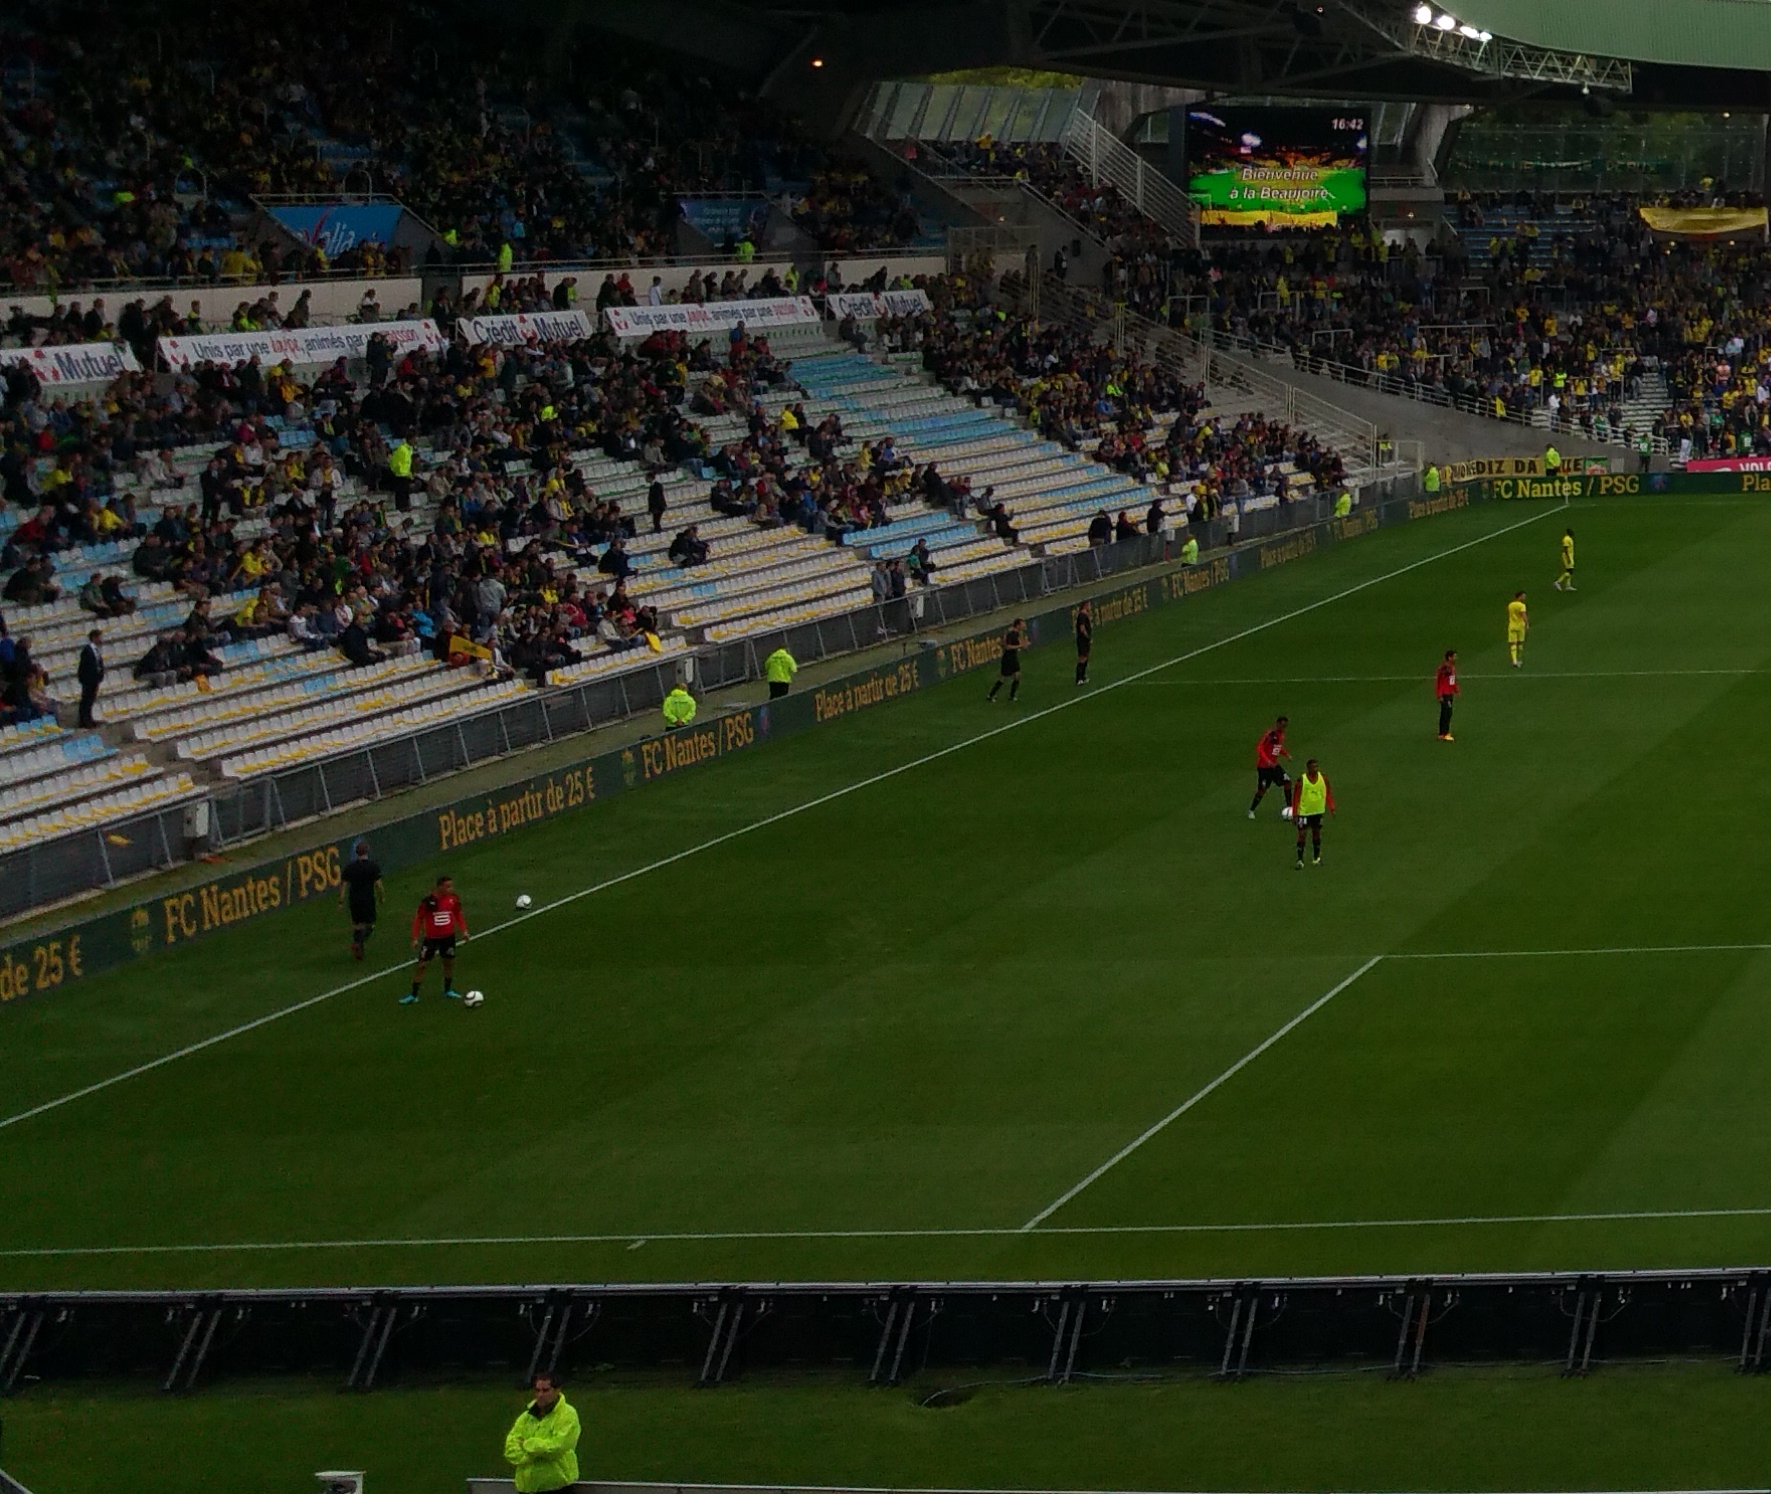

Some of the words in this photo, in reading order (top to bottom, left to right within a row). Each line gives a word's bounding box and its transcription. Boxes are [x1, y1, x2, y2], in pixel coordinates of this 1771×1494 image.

[1242, 167, 1319, 181] Bienvenue
[1229, 186, 1239, 200] à
[1243, 186, 1256, 199] la
[1260, 186, 1328, 204] Beaujoire
[886, 291, 924, 314] Mutuel
[473, 318, 521, 345] Crédit
[535, 316, 585, 341] Mutuel
[193, 341, 224, 360] Unis
[225, 342, 245, 361] par
[246, 342, 269, 356] une
[305, 334, 345, 353] animés
[346, 334, 366, 351] par
[54, 349, 126, 381] Mutuel
[1491, 478, 1513, 500] FC
[1516, 477, 1583, 499] Nantes
[1599, 474, 1640, 495] PSG
[950, 639, 965, 674] FC
[813, 688, 845, 723] Place
[854, 670, 884, 714] partir
[884, 669, 899, 698] de
[898, 660, 912, 694] 25
[911, 659, 920, 688] €
[640, 740, 663, 779] FC
[664, 734, 716, 772] Nantes
[724, 711, 755, 752] PSG
[438, 807, 485, 851] Place
[486, 798, 499, 833] à
[500, 783, 544, 834] partir
[545, 778, 565, 813] de
[563, 768, 585, 807] 25
[584, 765, 597, 799] €
[163, 893, 197, 946] FC
[199, 874, 282, 932] Nantes
[298, 845, 342, 899] PSG
[33, 939, 64, 991] 25
[68, 933, 84, 978] €
